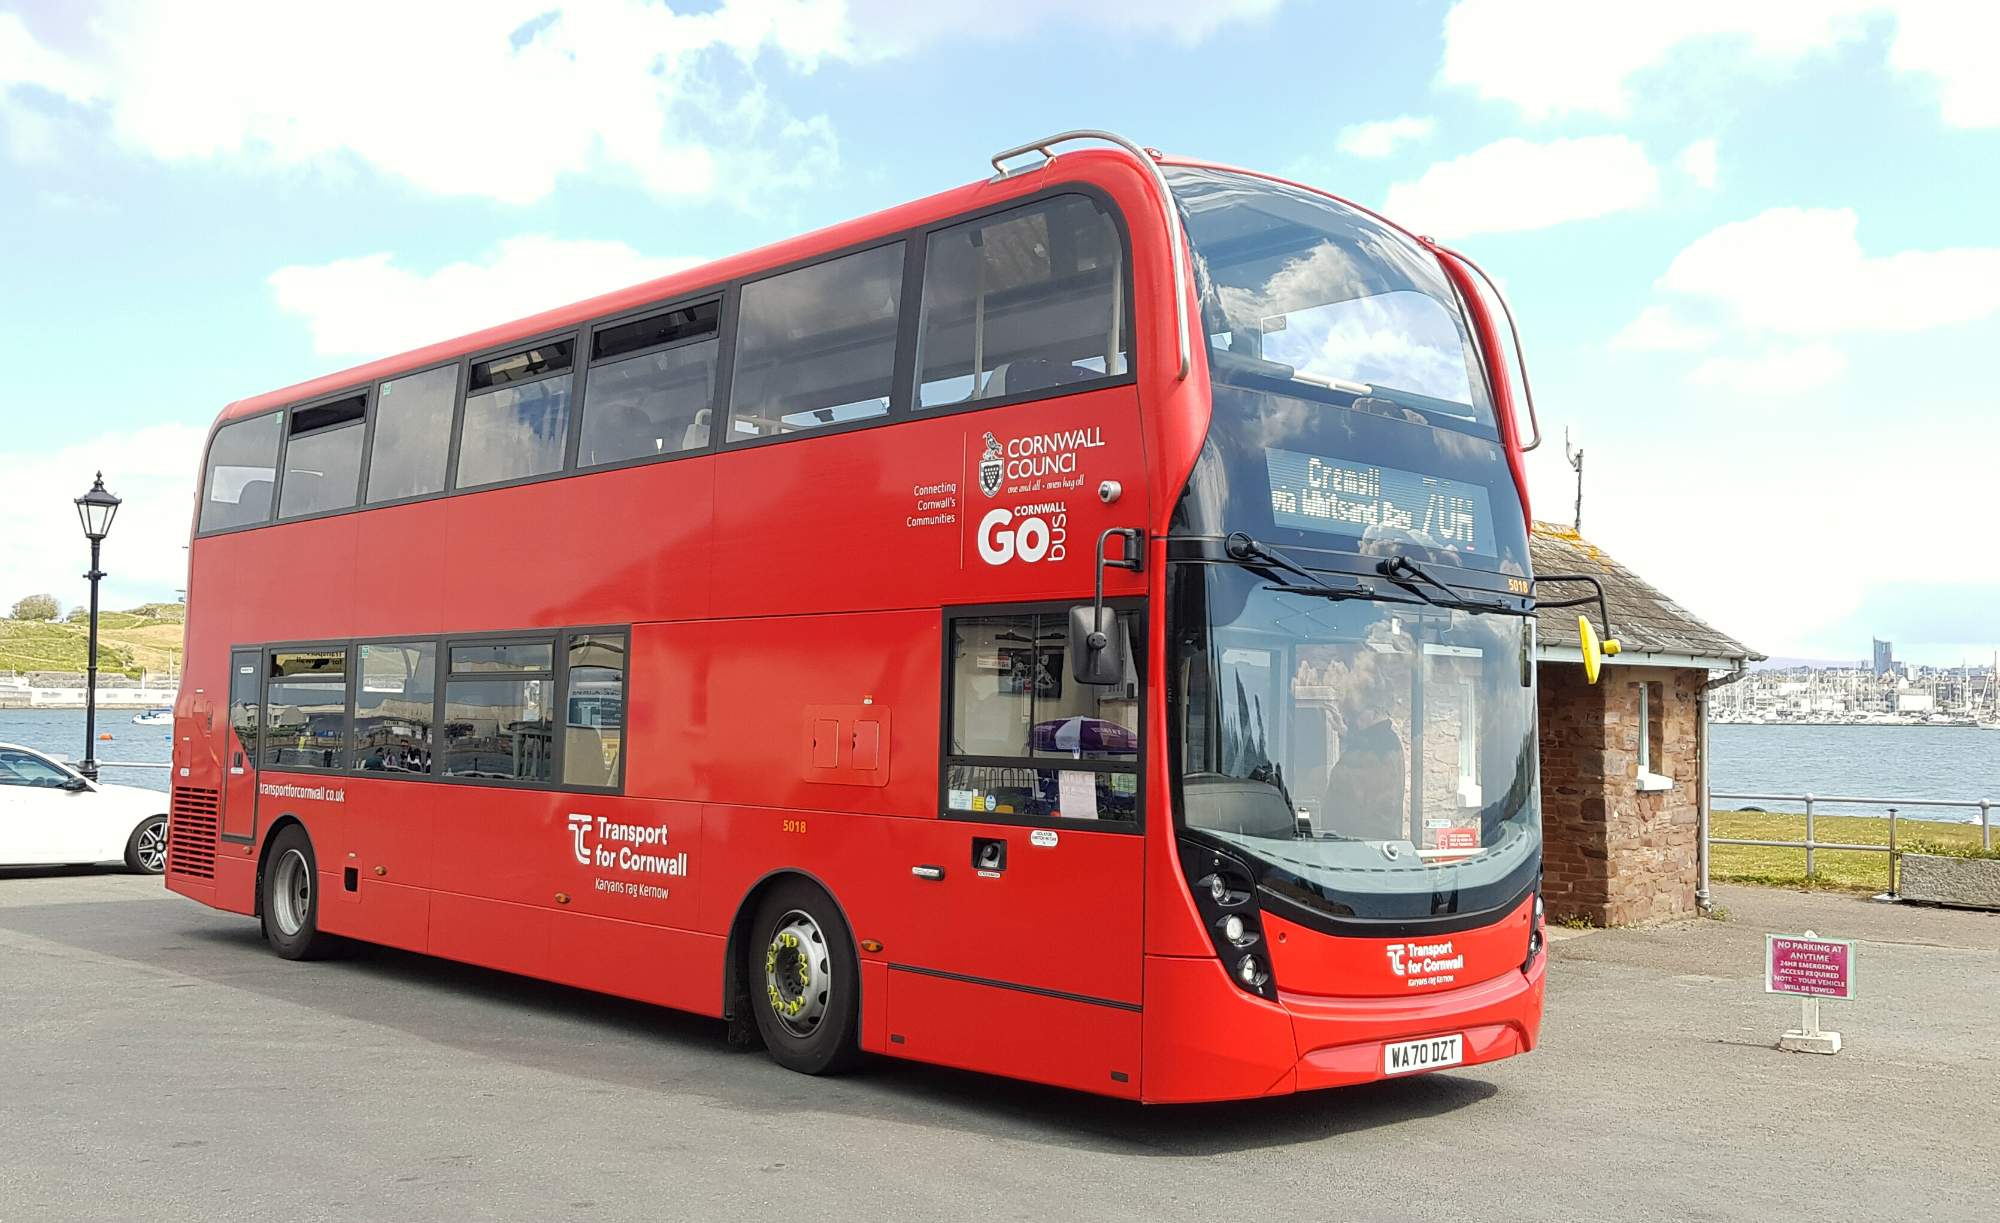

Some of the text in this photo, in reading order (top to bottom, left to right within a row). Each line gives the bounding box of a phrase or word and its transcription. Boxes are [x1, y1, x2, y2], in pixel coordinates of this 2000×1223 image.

[1007, 426, 1105, 458] CORNWALL
[1007, 453, 1077, 480] COUNCI
[913, 481, 957, 496] Connecting
[917, 497, 956, 511] Cornwall's
[1014, 501, 1067, 516] CORNWALL
[906, 513, 956, 527] Communities
[1507, 578, 1529, 594] 5018
[259, 782, 345, 803] transportforcornwall co.uk
[597, 816, 668, 847] Transport
[783, 819, 807, 833] 5018
[595, 844, 688, 877] for Cornwall
[595, 878, 669, 899] Karyans rag Kernow
[1407, 940, 1453, 958] Transport
[1777, 941, 1791, 949] NO
[1792, 943, 1830, 953] PARKING
[1407, 954, 1464, 974] for Cornwall
[1790, 952, 1830, 962] ANYTIME
[1780, 968, 1839, 979] ACCESS REQUIRED
[1798, 962, 1839, 971] EMERGENCY
[1817, 979, 1846, 987] VEHICLE
[1392, 1039, 1456, 1068] WA70 DZT
